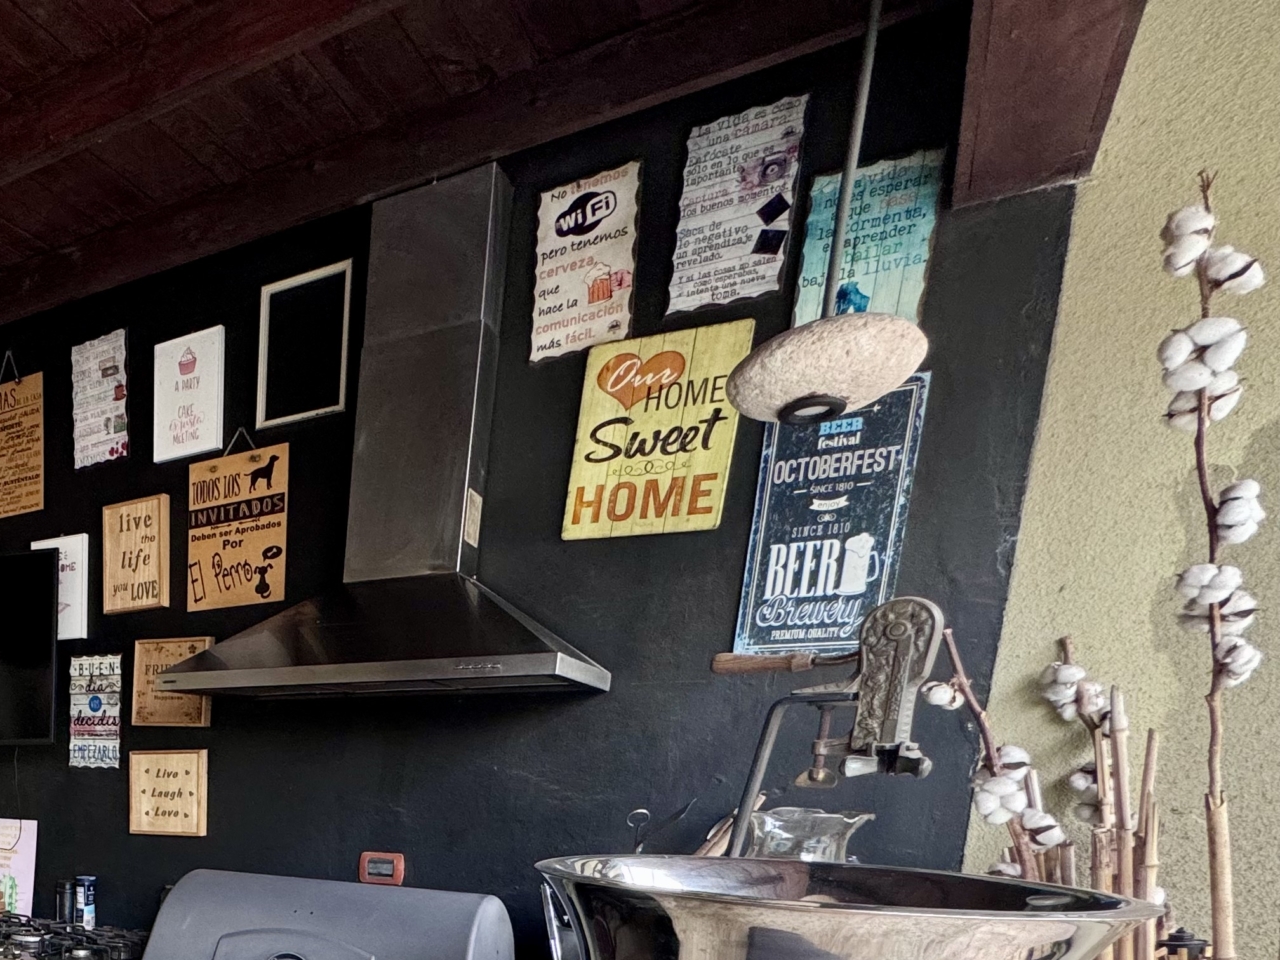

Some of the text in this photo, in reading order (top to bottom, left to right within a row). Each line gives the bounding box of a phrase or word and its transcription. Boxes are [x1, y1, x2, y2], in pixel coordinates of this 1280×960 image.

[698, 100, 801, 138] La vida es como
[708, 134, 729, 146] una
[686, 145, 774, 178] sólo en lo que es
[688, 144, 742, 168] Enfócate
[551, 168, 629, 202] No tenemos
[685, 165, 745, 187] importante
[870, 165, 908, 184] vida
[870, 173, 932, 198] esperar
[681, 206, 696, 219] los
[700, 197, 734, 213] buenos
[682, 189, 729, 207] Captura
[879, 192, 916, 213] pase
[680, 221, 722, 239] Saca de
[816, 207, 927, 241] la ormenta,
[541, 226, 628, 266] pero tenemos
[677, 225, 749, 250] lo negativo
[844, 222, 916, 249] aprender
[676, 234, 753, 260] un aprendizaje
[845, 242, 903, 264] bailar
[678, 256, 777, 284] Y si las cosas no salen
[802, 272, 826, 289] baj
[838, 268, 855, 281] la
[538, 285, 560, 301] que
[686, 275, 766, 297] intenta una nueva
[693, 279, 712, 288] como
[536, 302, 624, 336] comunicación
[538, 299, 578, 317] hace la
[536, 338, 561, 353] más
[174, 376, 200, 392] A PARTY
[606, 358, 678, 392] Our
[644, 374, 728, 413] HOME
[178, 403, 194, 419] CAKE
[173, 428, 199, 445] MEETING
[584, 408, 728, 463] Sweet
[818, 417, 863, 436] BEER
[817, 432, 861, 449] festival
[773, 445, 902, 484] OCTOBERFEST
[192, 473, 241, 506] TODOS LOS
[571, 472, 718, 525] HOME
[810, 481, 854, 494] SINCE 1810
[190, 495, 284, 526] INVITADOS
[817, 501, 841, 509] enjoy
[119, 513, 152, 533] live
[191, 521, 282, 542] Deben ser Aprobados
[792, 522, 851, 538] SINCE 1810
[141, 534, 156, 544] the
[223, 539, 244, 550] Por
[121, 548, 151, 573] life
[763, 539, 841, 600] BEER
[189, 552, 254, 604] El Perro
[113, 580, 158, 601] you LOVE
[756, 595, 865, 638] Brewery
[771, 627, 840, 640] PREMIUM QUALITY
[73, 744, 118, 762] EMPEZARLO
[151, 788, 183, 801] Laugh
